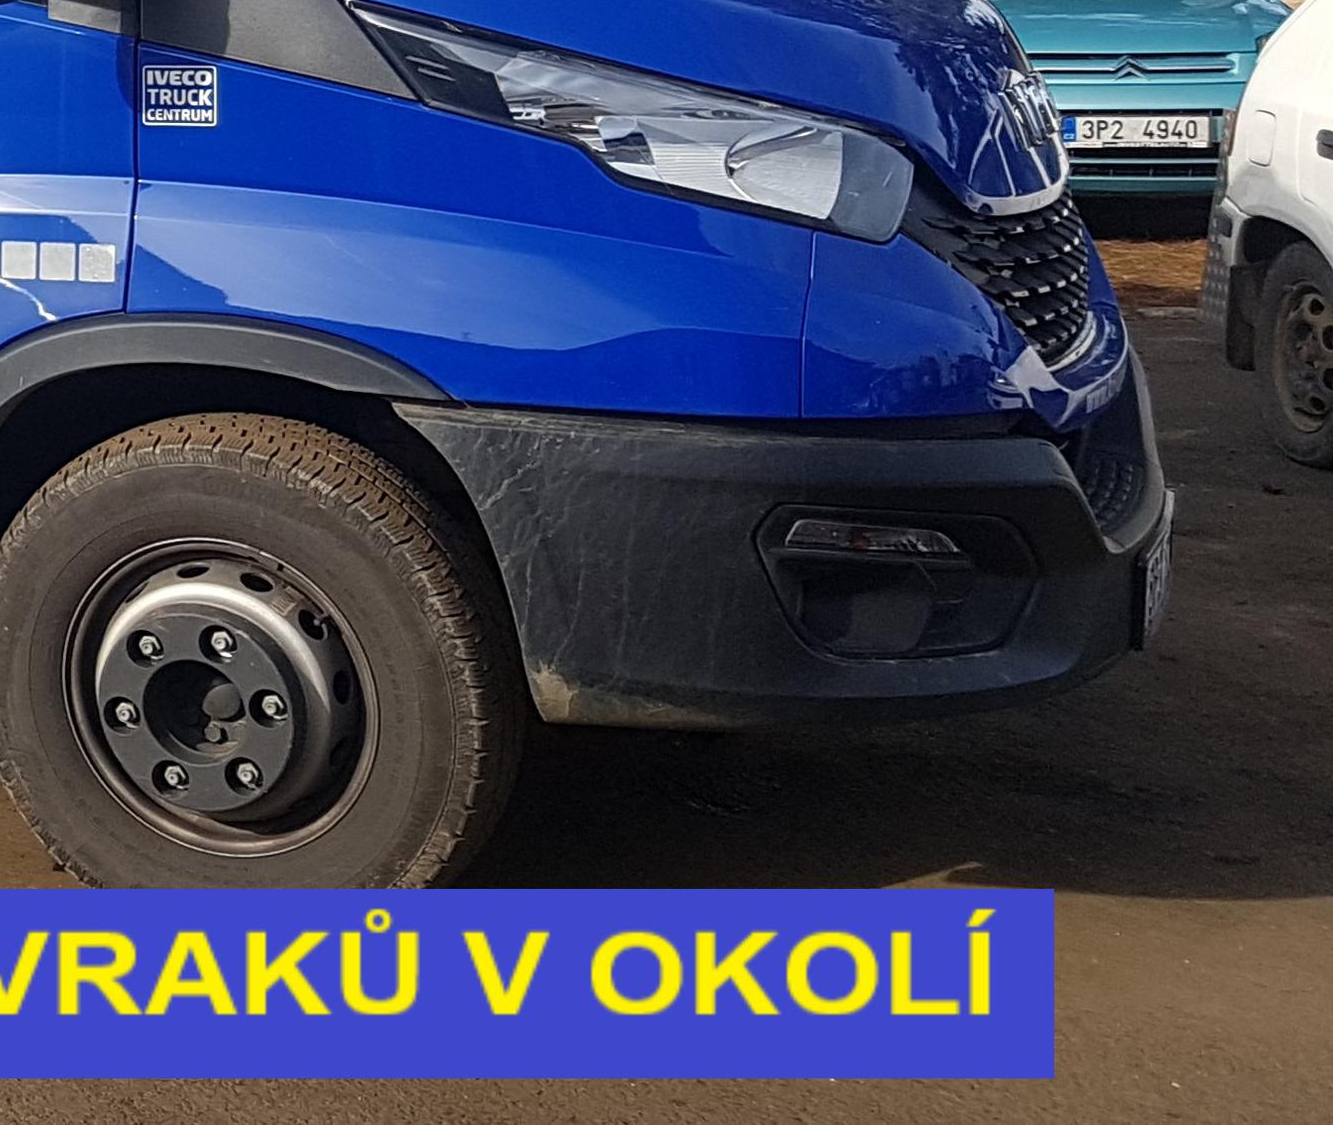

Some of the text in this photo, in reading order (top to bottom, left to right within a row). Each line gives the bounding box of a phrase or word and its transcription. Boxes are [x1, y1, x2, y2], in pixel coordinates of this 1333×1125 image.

[146, 70, 213, 86] IVECO
[147, 88, 213, 106] TRUCK
[147, 108, 213, 122] CENTRUM
[1082, 120, 1198, 139] 3P2 4940
